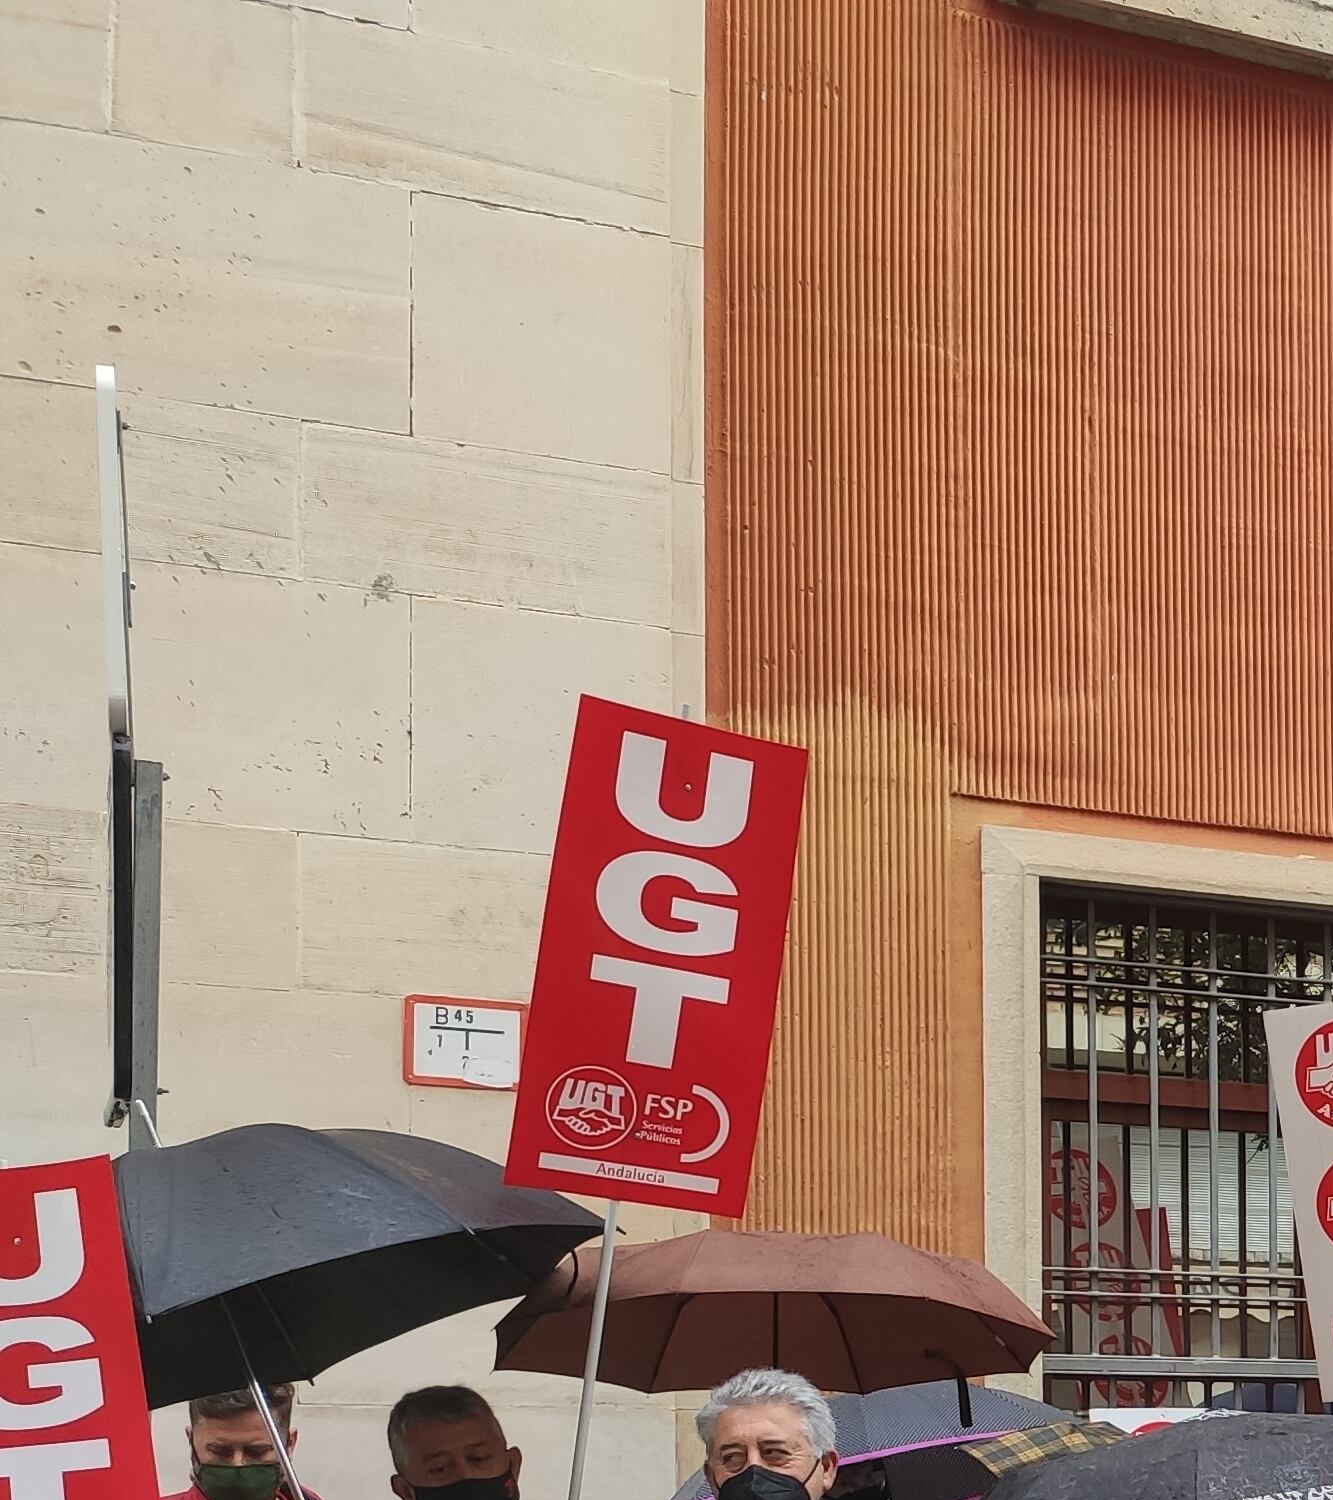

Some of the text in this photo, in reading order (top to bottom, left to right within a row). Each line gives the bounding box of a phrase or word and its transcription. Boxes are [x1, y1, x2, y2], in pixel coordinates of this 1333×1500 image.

[589, 730, 756, 1069] UGT
[435, 1006, 449, 1025] B
[558, 1078, 626, 1118] UGT
[643, 1093, 694, 1121] FSP
[641, 1120, 683, 1136] Servicios
[595, 1162, 665, 1184] Andalucía
